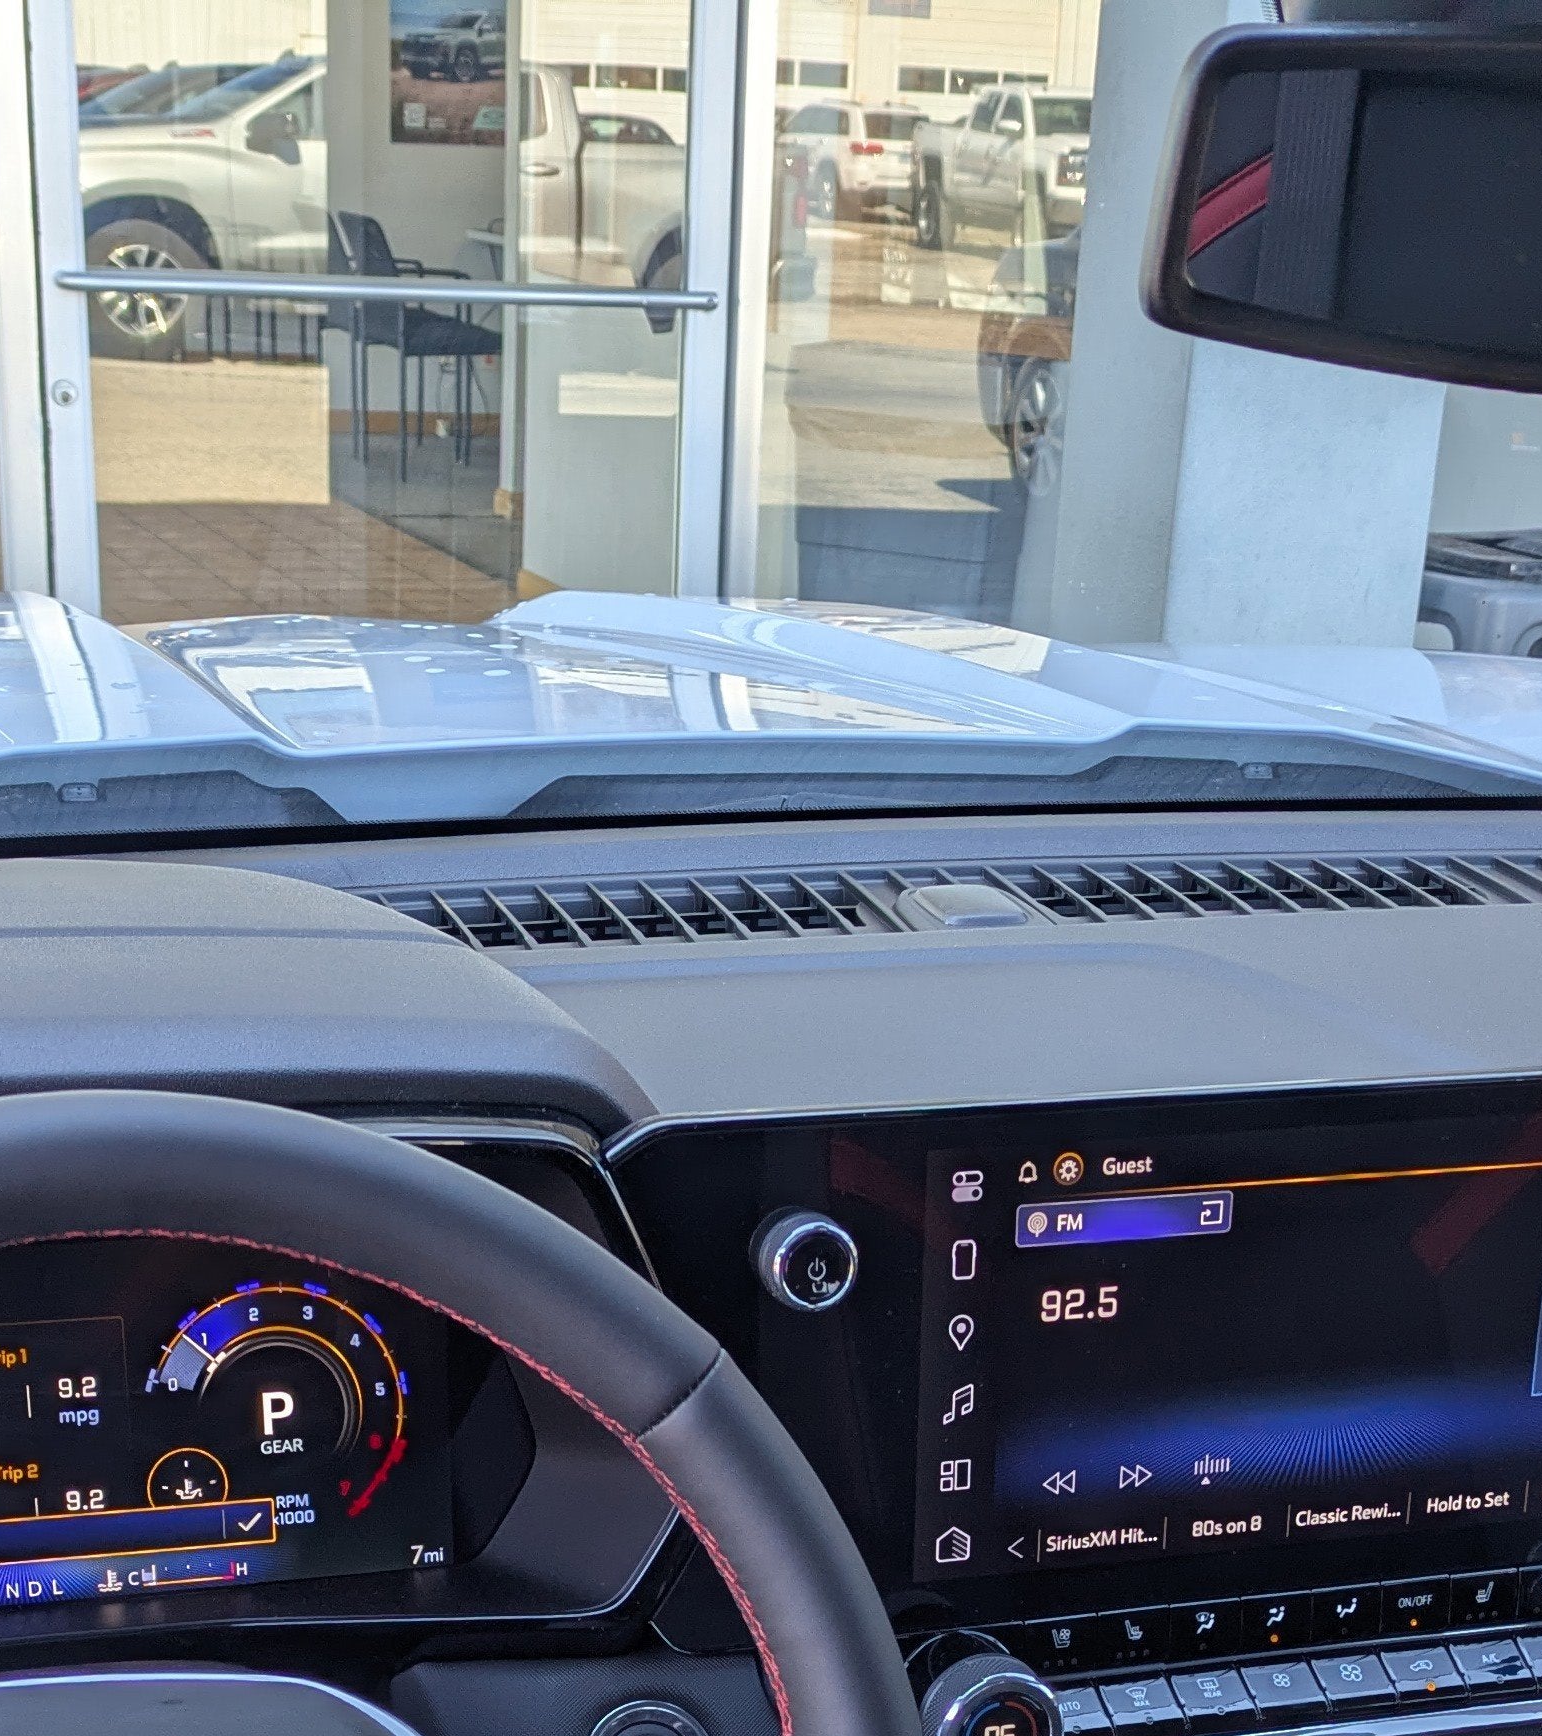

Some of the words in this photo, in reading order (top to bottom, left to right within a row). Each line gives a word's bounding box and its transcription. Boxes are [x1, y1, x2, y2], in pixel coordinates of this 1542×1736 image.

[1102, 1156, 1153, 1177] Guest
[1056, 1213, 1084, 1231] FM
[1040, 1285, 1120, 1323] 92.5
[248, 1308, 259, 1322] 2
[302, 1306, 314, 1321] 3
[349, 1333, 361, 1348] 4
[19, 1348, 29, 1364] 1
[58, 1377, 97, 1398] 9.2
[167, 1378, 178, 1392] 0
[375, 1382, 386, 1397] 5
[58, 1408, 100, 1427] mpg
[261, 1391, 295, 1436] P
[260, 1438, 304, 1455] GEAR
[26, 1463, 39, 1479] 2
[65, 1490, 105, 1512] 9.2
[276, 1494, 309, 1509] RPM
[1426, 1493, 1462, 1514] Hold
[1464, 1493, 1481, 1509] to
[1484, 1491, 1510, 1508] Set
[273, 1509, 315, 1526] x1000
[1295, 1506, 1348, 1529] Classic
[1351, 1502, 1401, 1522] Rewi...
[1192, 1519, 1223, 1538] 80s
[1225, 1521, 1248, 1535] on
[1250, 1515, 1262, 1533] 8
[1045, 1531, 1118, 1554] SiriusXM
[1120, 1528, 1158, 1546] Hit...
[127, 1571, 139, 1587] C
[236, 1562, 248, 1577] H
[6, 1582, 19, 1597] N
[28, 1581, 42, 1597] D
[52, 1579, 64, 1595] L
[1398, 1594, 1433, 1609] ON/OFF
[1481, 1652, 1499, 1665] A/C
[1133, 1699, 1150, 1708] MAX
